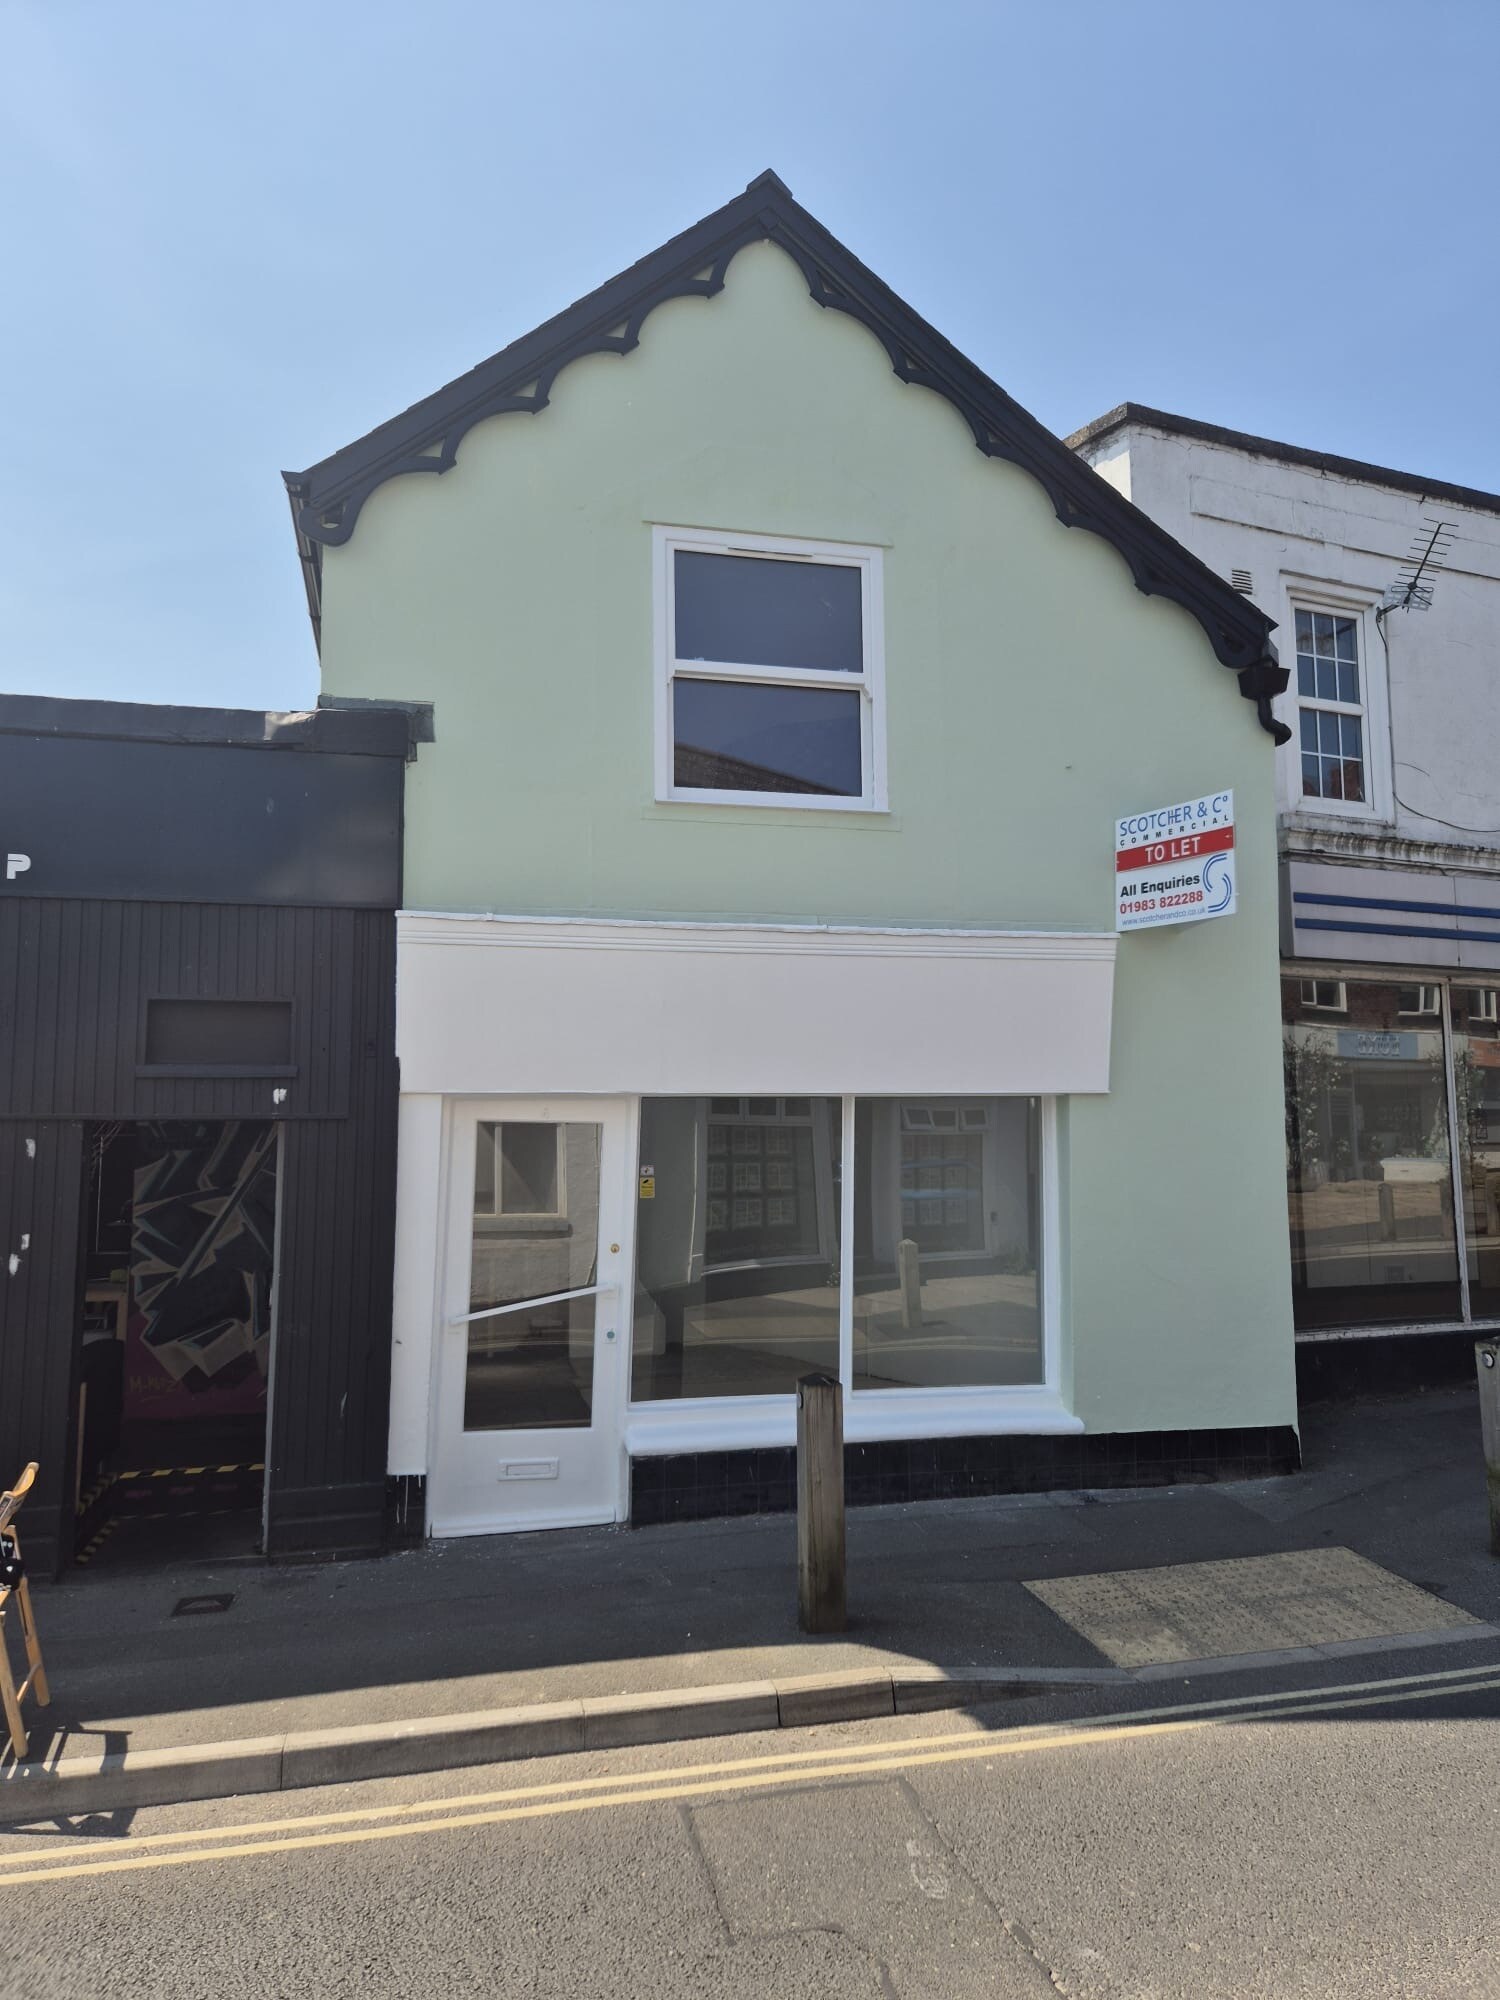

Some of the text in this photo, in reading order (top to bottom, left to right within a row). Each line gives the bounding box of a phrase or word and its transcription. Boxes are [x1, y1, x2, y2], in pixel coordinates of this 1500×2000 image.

[1120, 805, 1192, 836] SCOTCHER
[1197, 801, 1207, 818] &
[1120, 815, 1228, 846] COMMERCIAL
[1145, 836, 1201, 863] TO LET
[7, 853, 31, 880] P
[1120, 874, 1200, 898] All Enquiries
[1120, 890, 1203, 915] 01983 822288
